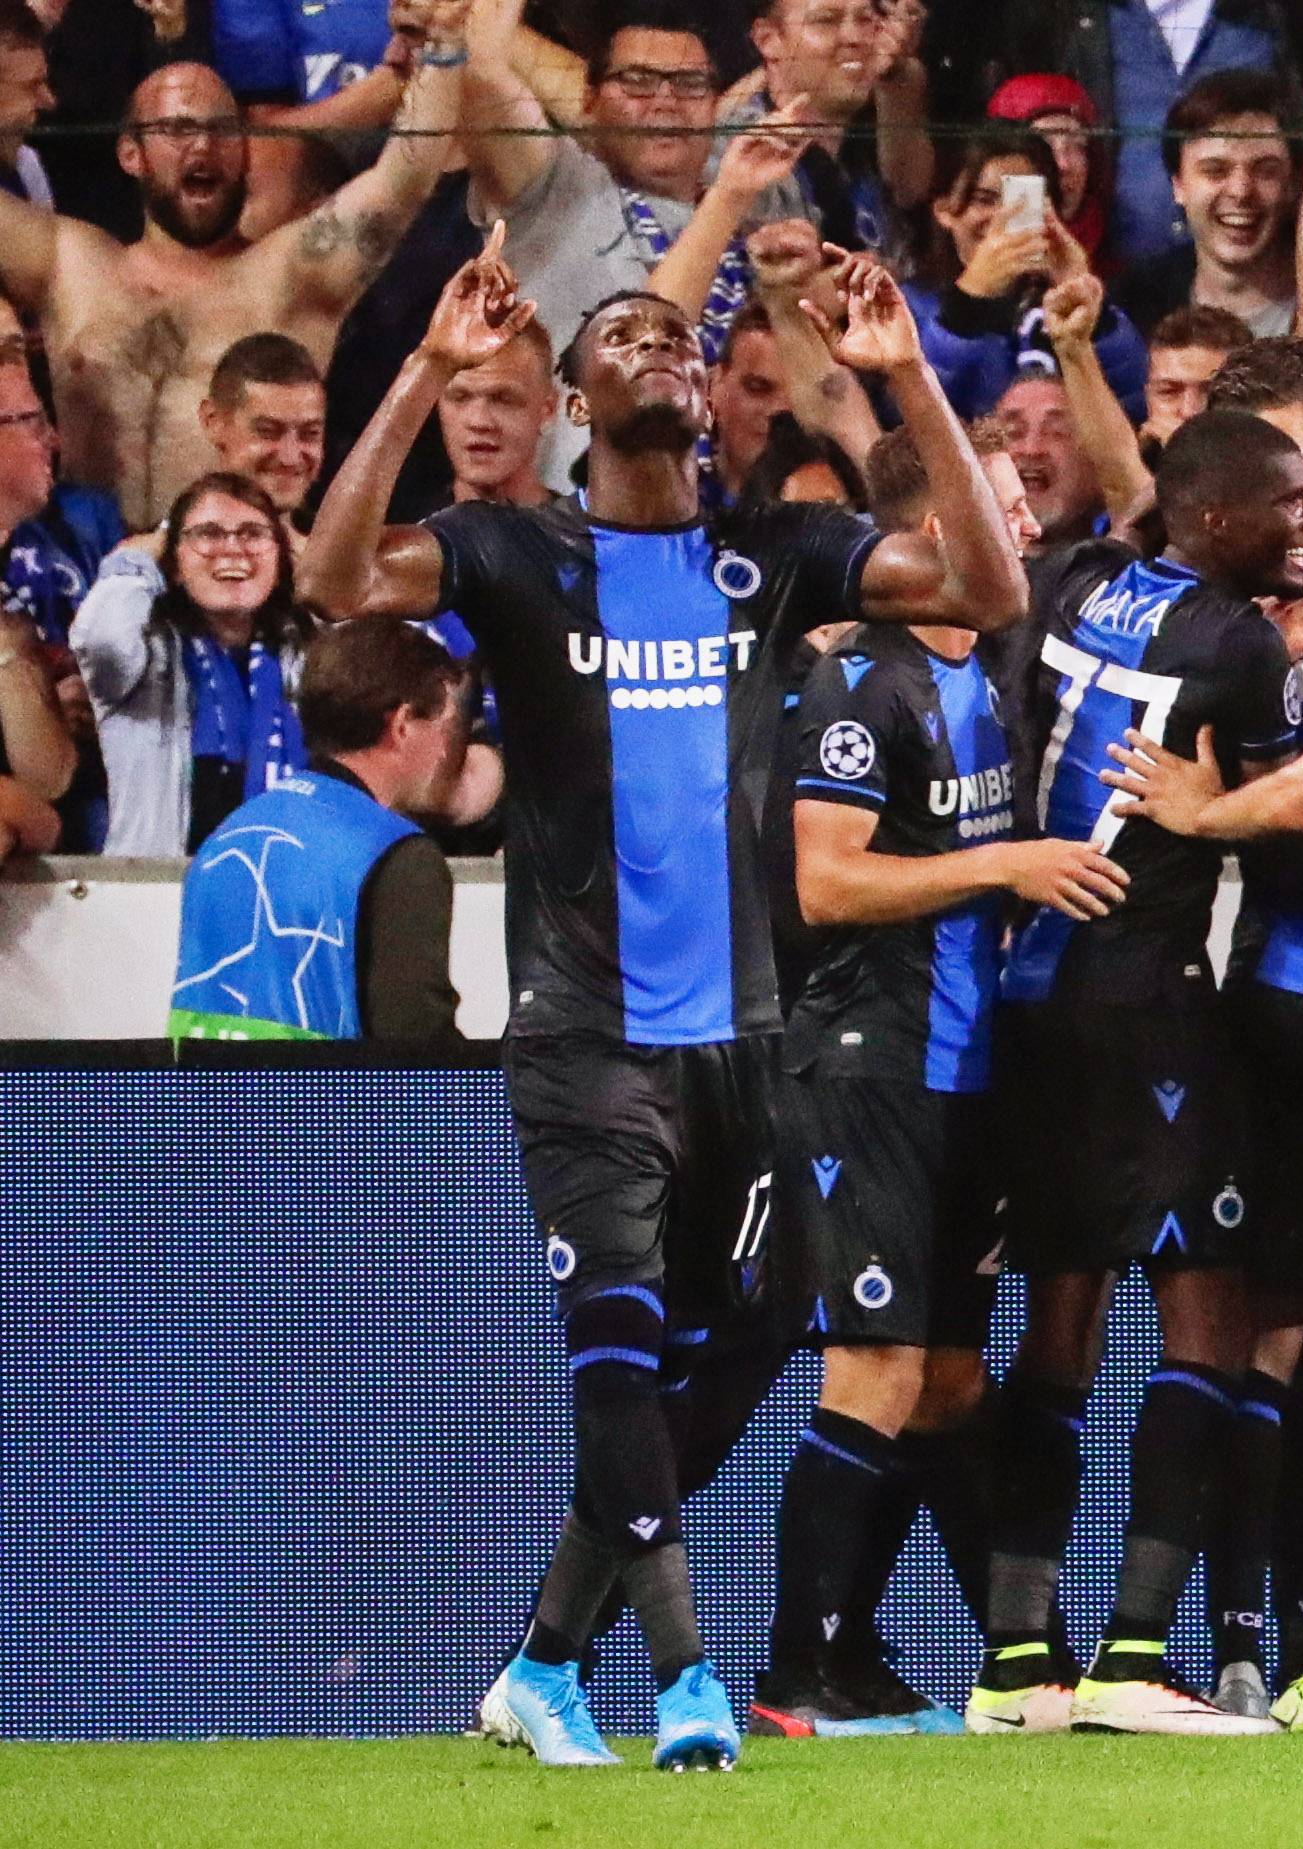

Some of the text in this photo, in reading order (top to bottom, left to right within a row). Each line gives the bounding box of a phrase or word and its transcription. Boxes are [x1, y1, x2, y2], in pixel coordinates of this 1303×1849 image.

[1078, 580, 1170, 636] MATA
[568, 630, 757, 681] UNIBET
[1036, 633, 1183, 856] 77
[928, 763, 1013, 816] UNIBE
[732, 1170, 773, 1261] 17
[1223, 1610, 1264, 1629] FCB
